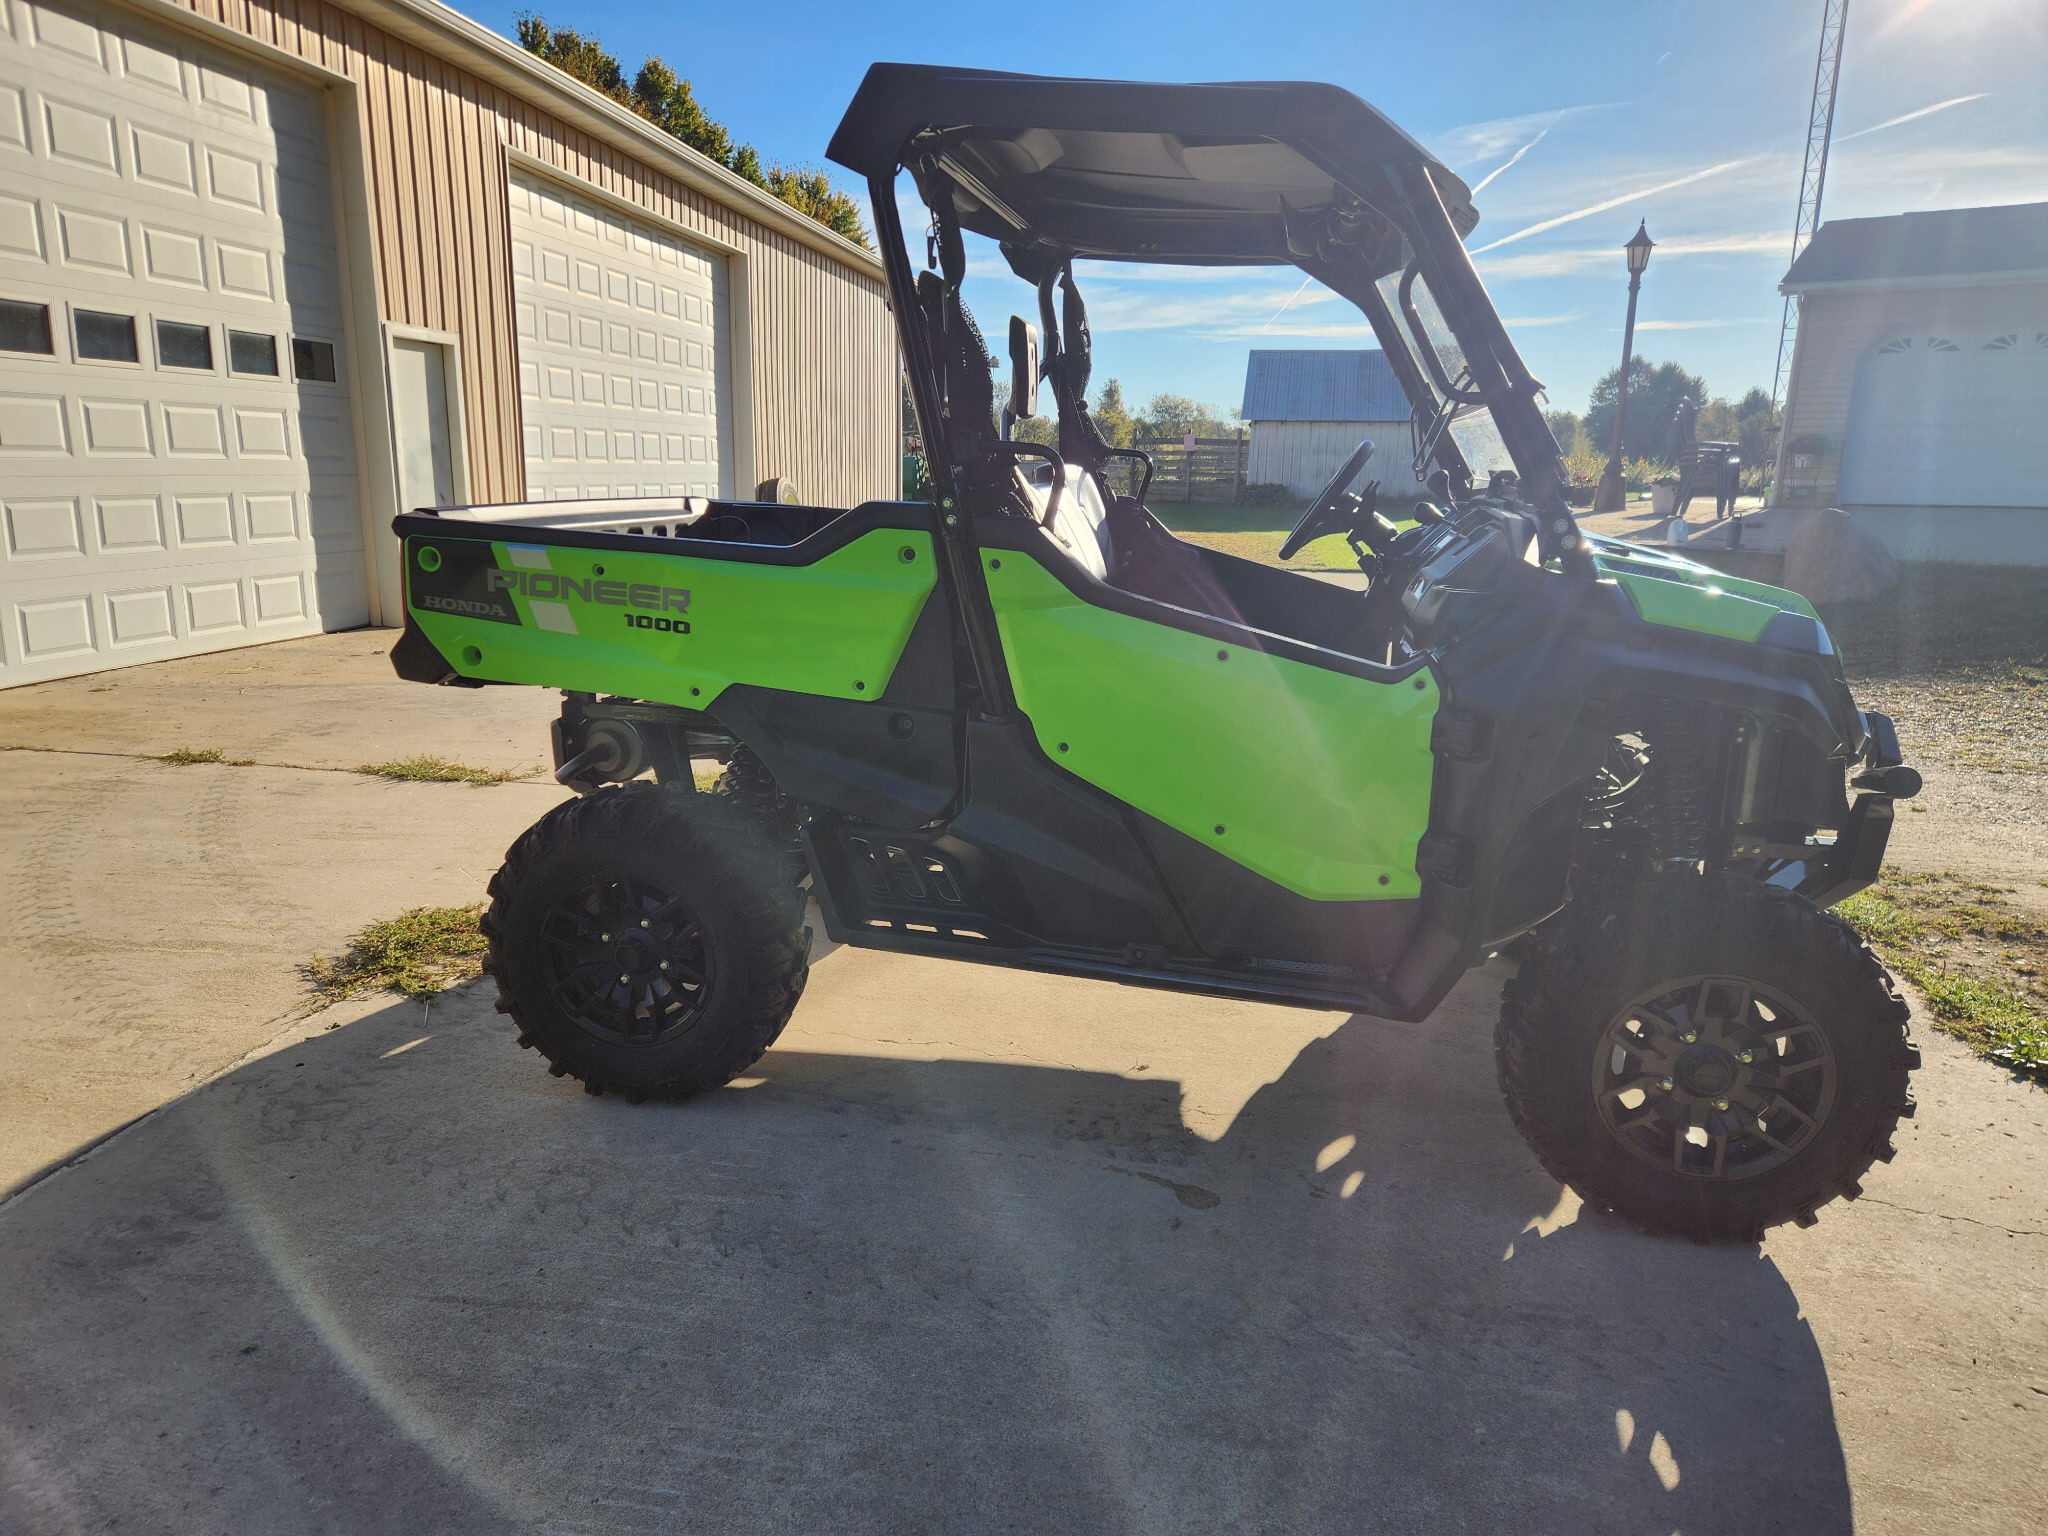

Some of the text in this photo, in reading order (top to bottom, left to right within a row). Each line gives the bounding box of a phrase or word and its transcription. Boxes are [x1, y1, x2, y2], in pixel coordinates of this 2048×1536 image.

[487, 568, 691, 614] PIONEER
[424, 595, 506, 617] HONDA
[624, 613, 691, 634] 1000
